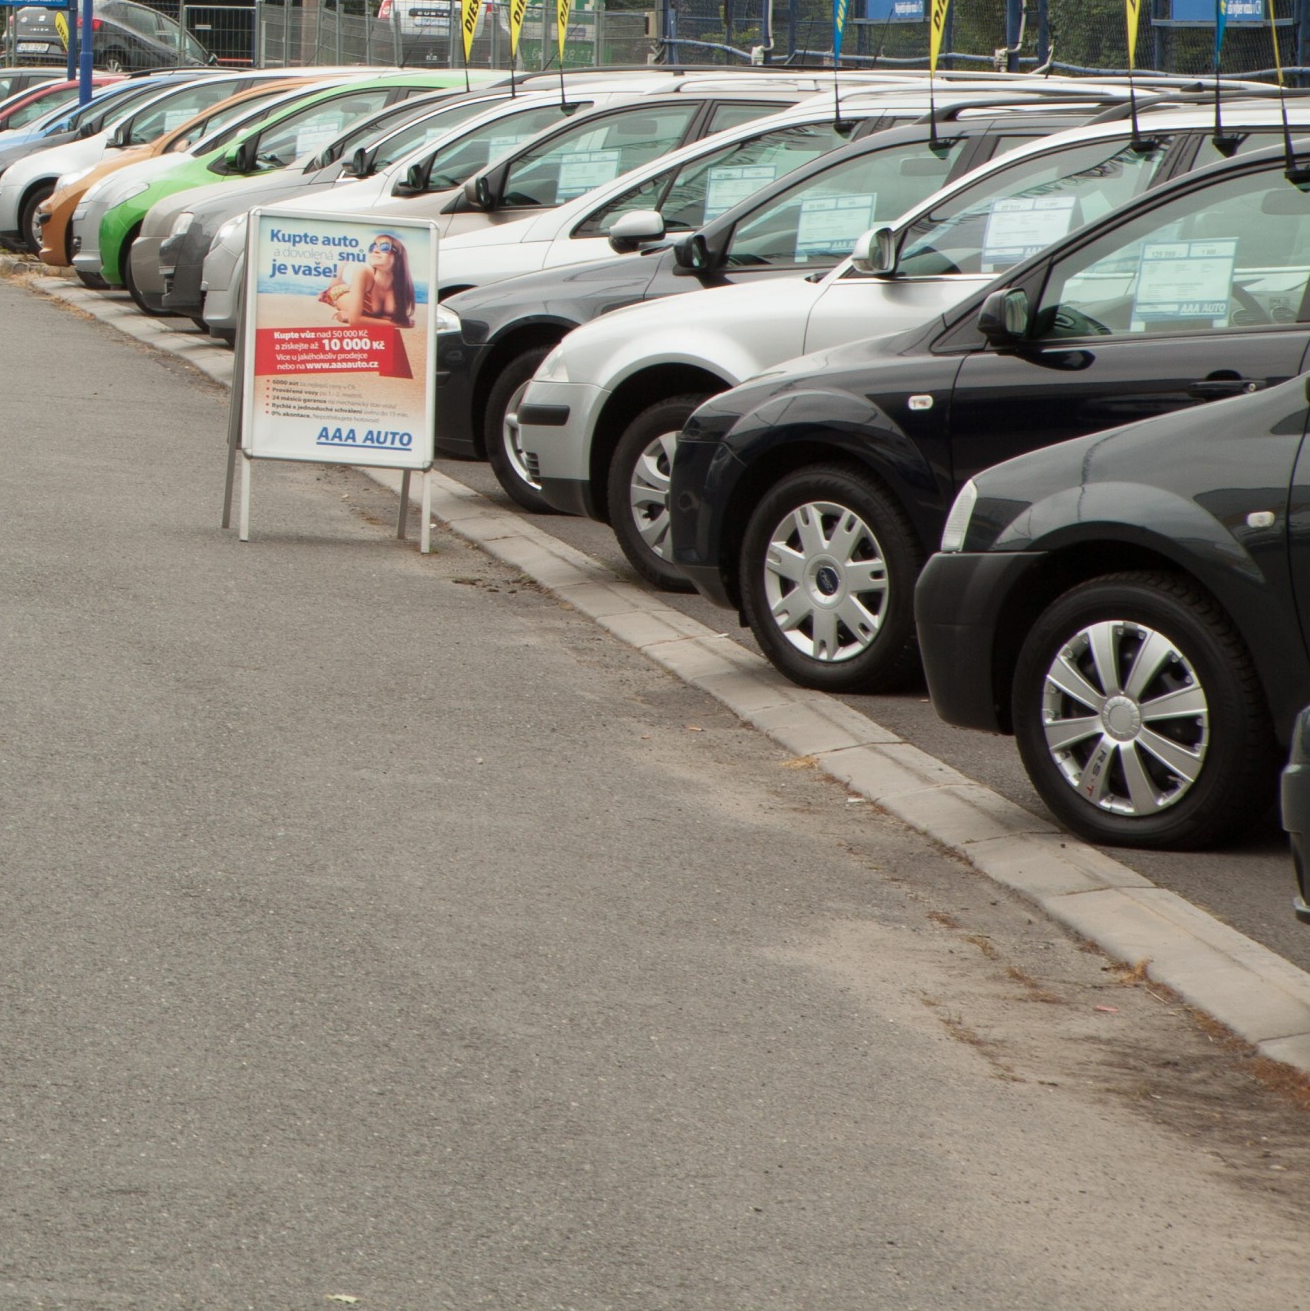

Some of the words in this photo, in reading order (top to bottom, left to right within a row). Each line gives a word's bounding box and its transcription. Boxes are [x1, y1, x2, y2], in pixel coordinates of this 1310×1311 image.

[270, 229, 319, 247] Kupte
[322, 235, 359, 248] auto
[274, 249, 280, 257] a
[282, 247, 334, 260] dovolená
[338, 248, 366, 263] snů
[269, 258, 287, 278] je
[291, 261, 338, 278] vaše!
[1181, 304, 1199, 313] AAA
[1202, 303, 1226, 312] AUTO
[274, 331, 299, 340] Kupte
[299, 330, 315, 339] vůz
[317, 330, 331, 338] nad
[333, 330, 342, 338] 50
[343, 330, 358, 338] 000
[359, 329, 368, 338] Kč
[280, 341, 308, 352] získejte
[310, 341, 318, 350] až
[322, 339, 340, 351] 10
[342, 338, 370, 350] 000
[373, 339, 385, 350] Kč
[275, 353, 290, 361] Více
[297, 352, 336, 361] jakéhokoliv
[338, 352, 368, 361] prodejce
[277, 362, 295, 370] nebo
[306, 361, 379, 370] www.aaaauto.cz
[317, 427, 357, 443] AAA
[363, 430, 412, 447] AUTO
